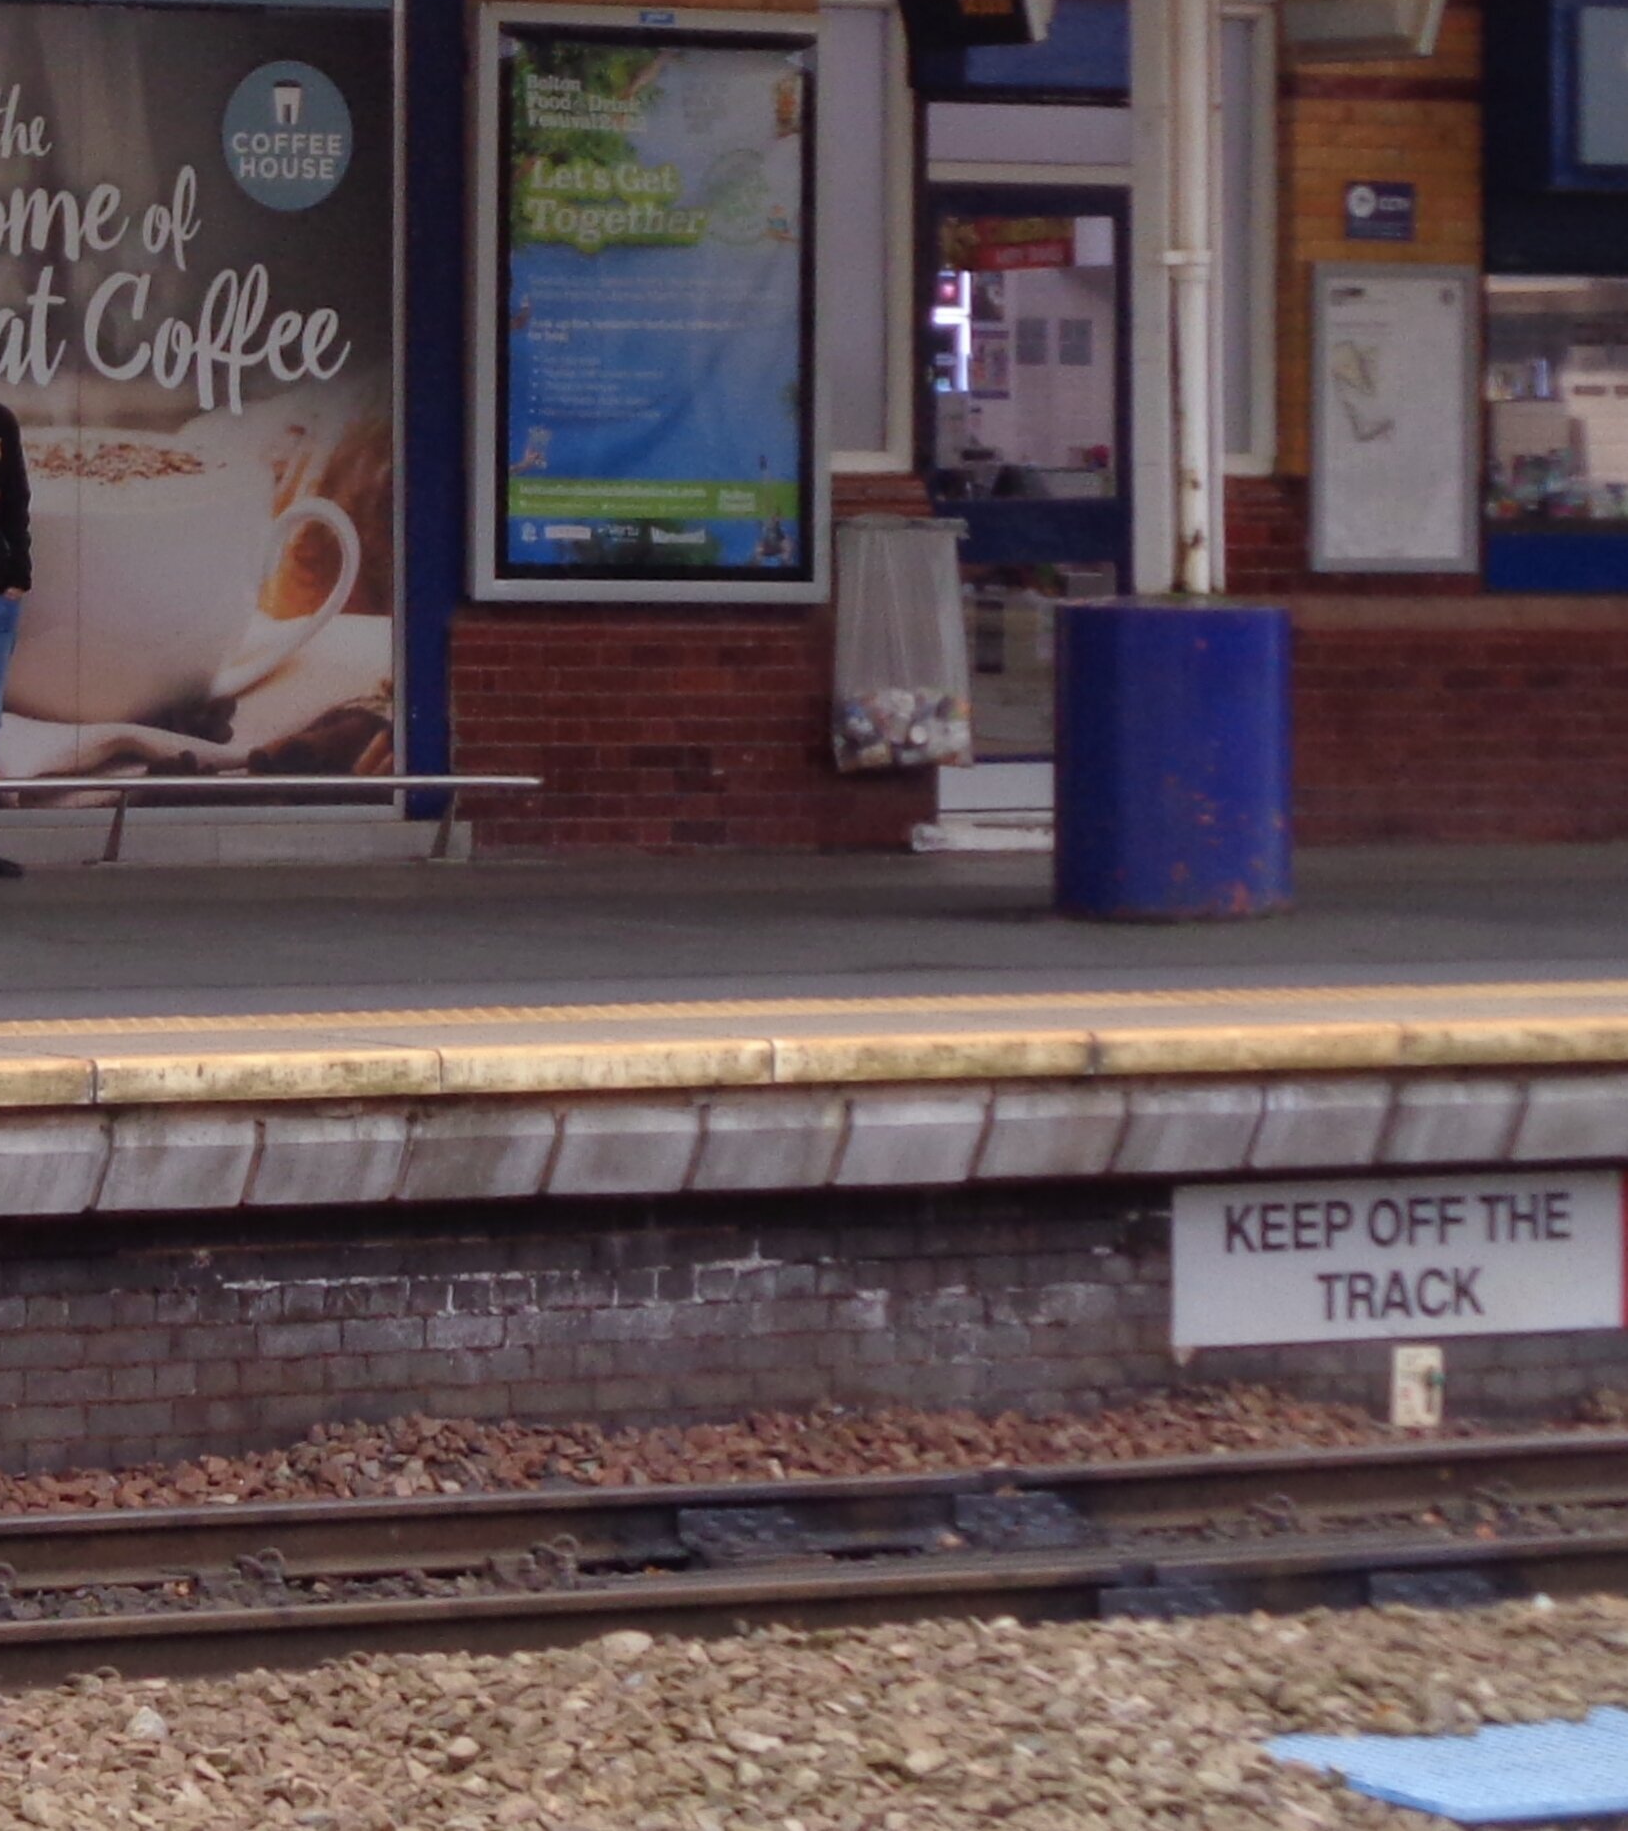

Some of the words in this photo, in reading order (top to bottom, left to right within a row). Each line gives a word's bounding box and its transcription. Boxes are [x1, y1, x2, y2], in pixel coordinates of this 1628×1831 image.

[231, 133, 342, 158] COFFEE
[239, 155, 336, 181] HOUSE
[530, 159, 611, 192] Let's
[616, 163, 678, 194] Get
[141, 165, 202, 268] of
[527, 198, 709, 242] Together
[84, 262, 351, 416] Coffee
[1223, 1200, 1354, 1254] KEEP
[1368, 1195, 1467, 1248] OFF
[1479, 1191, 1572, 1242] THE
[1316, 1266, 1485, 1322] TRACK
